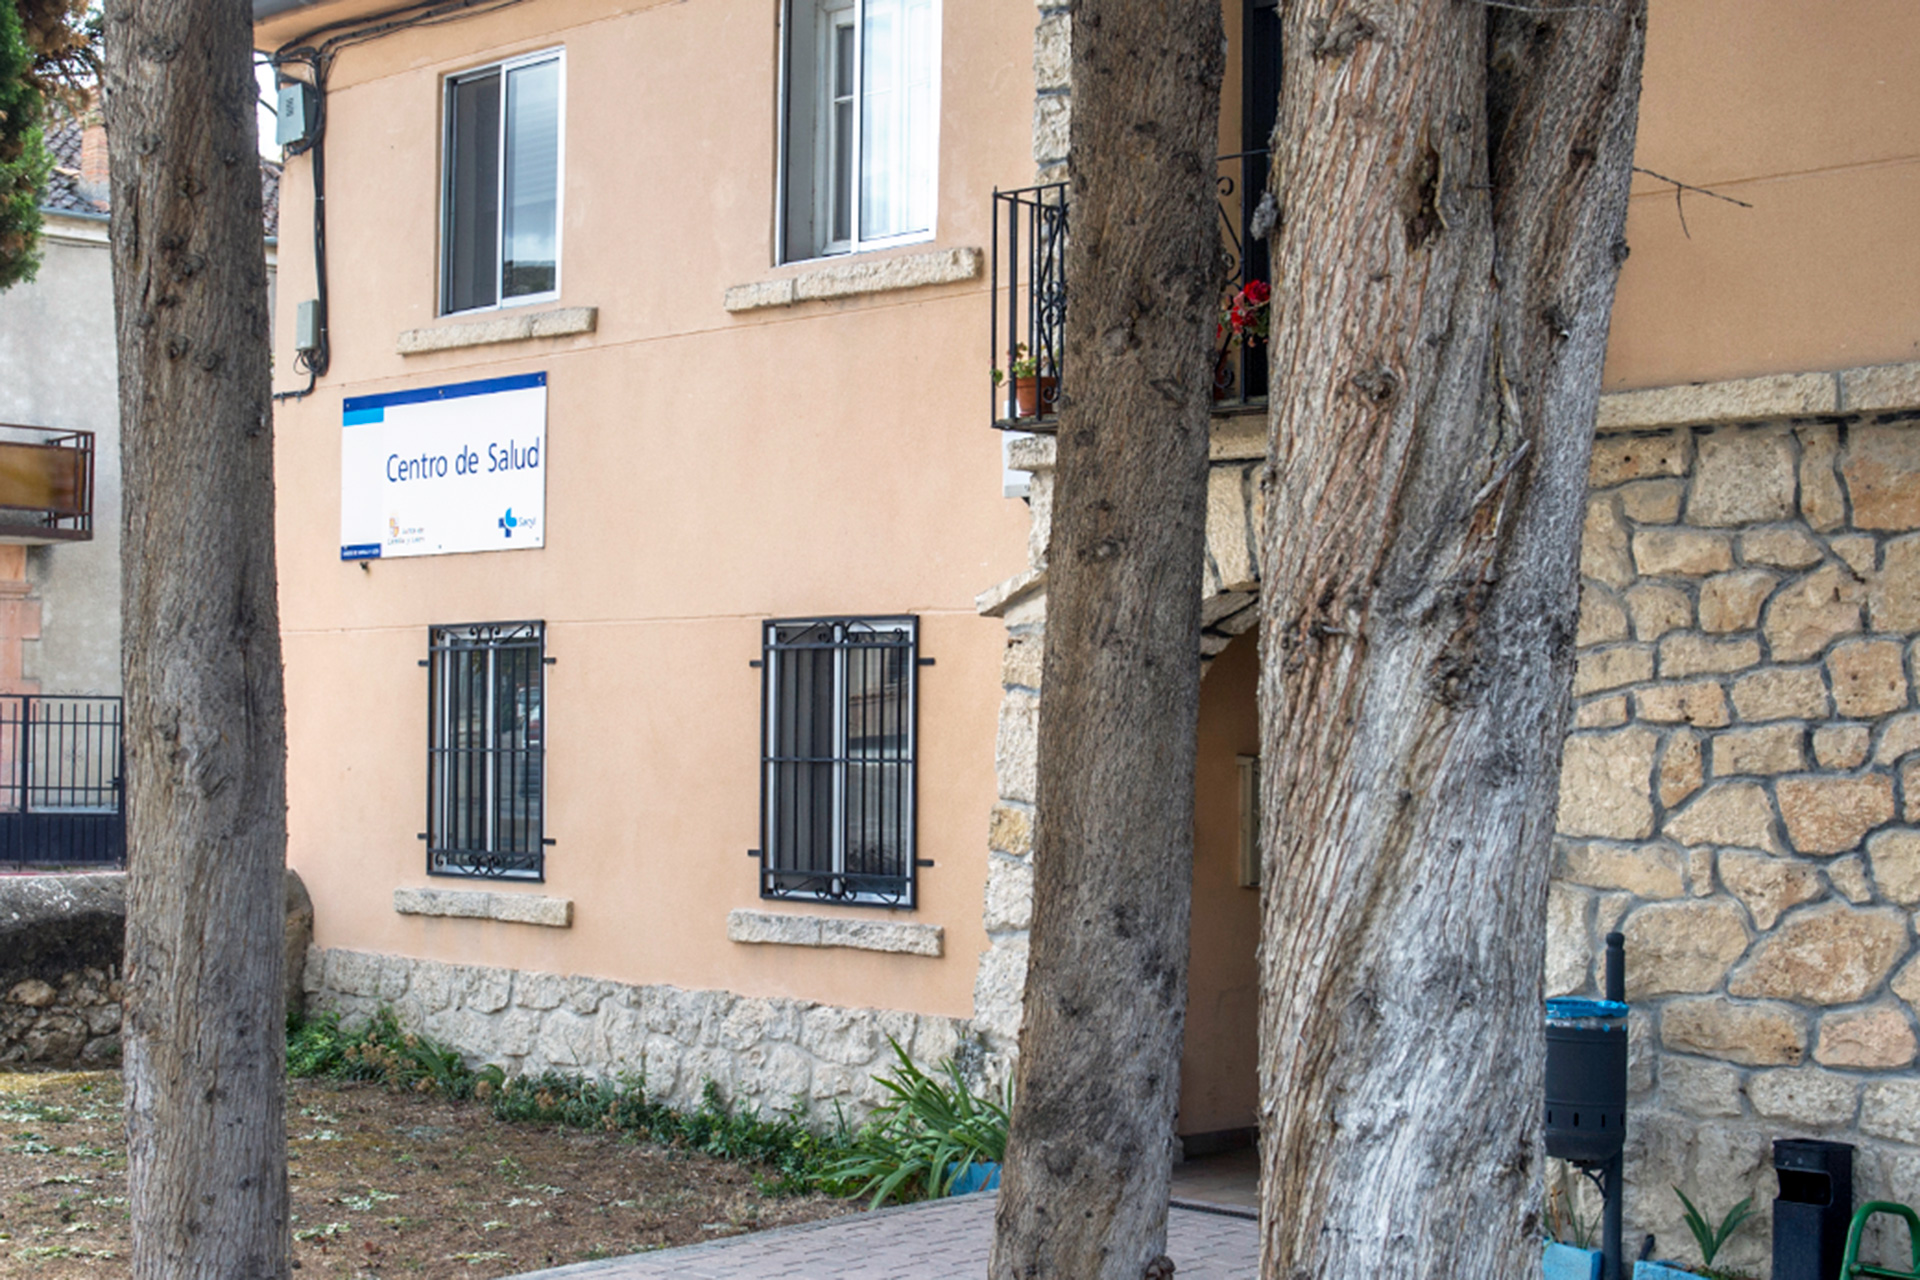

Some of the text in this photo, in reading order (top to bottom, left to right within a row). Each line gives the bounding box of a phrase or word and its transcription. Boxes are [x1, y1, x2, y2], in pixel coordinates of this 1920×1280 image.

[386, 436, 540, 482] Centro de Salud
